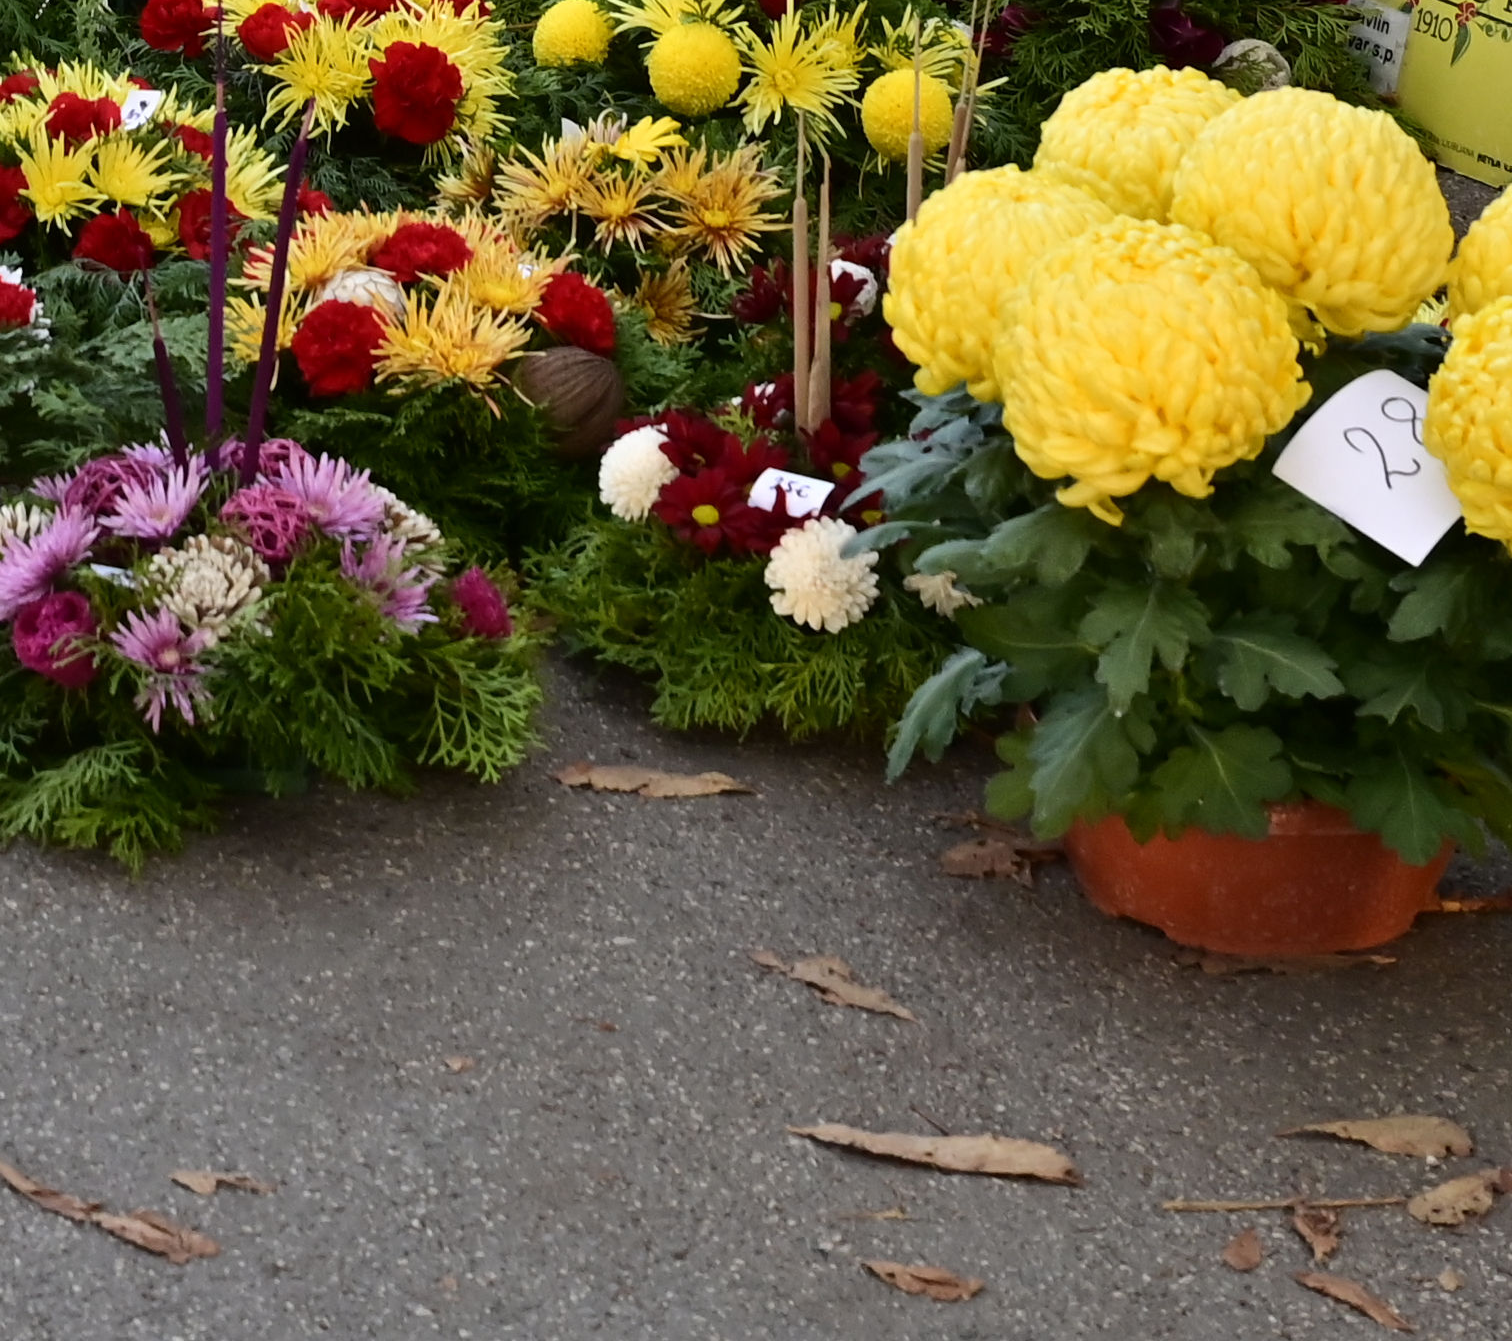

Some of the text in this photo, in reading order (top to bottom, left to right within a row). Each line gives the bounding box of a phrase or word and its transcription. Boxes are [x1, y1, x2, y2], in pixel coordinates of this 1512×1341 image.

[1359, 12, 1390, 35] avlin
[1413, 8, 1454, 42] 1910
[1347, 36, 1396, 65] var s.p.
